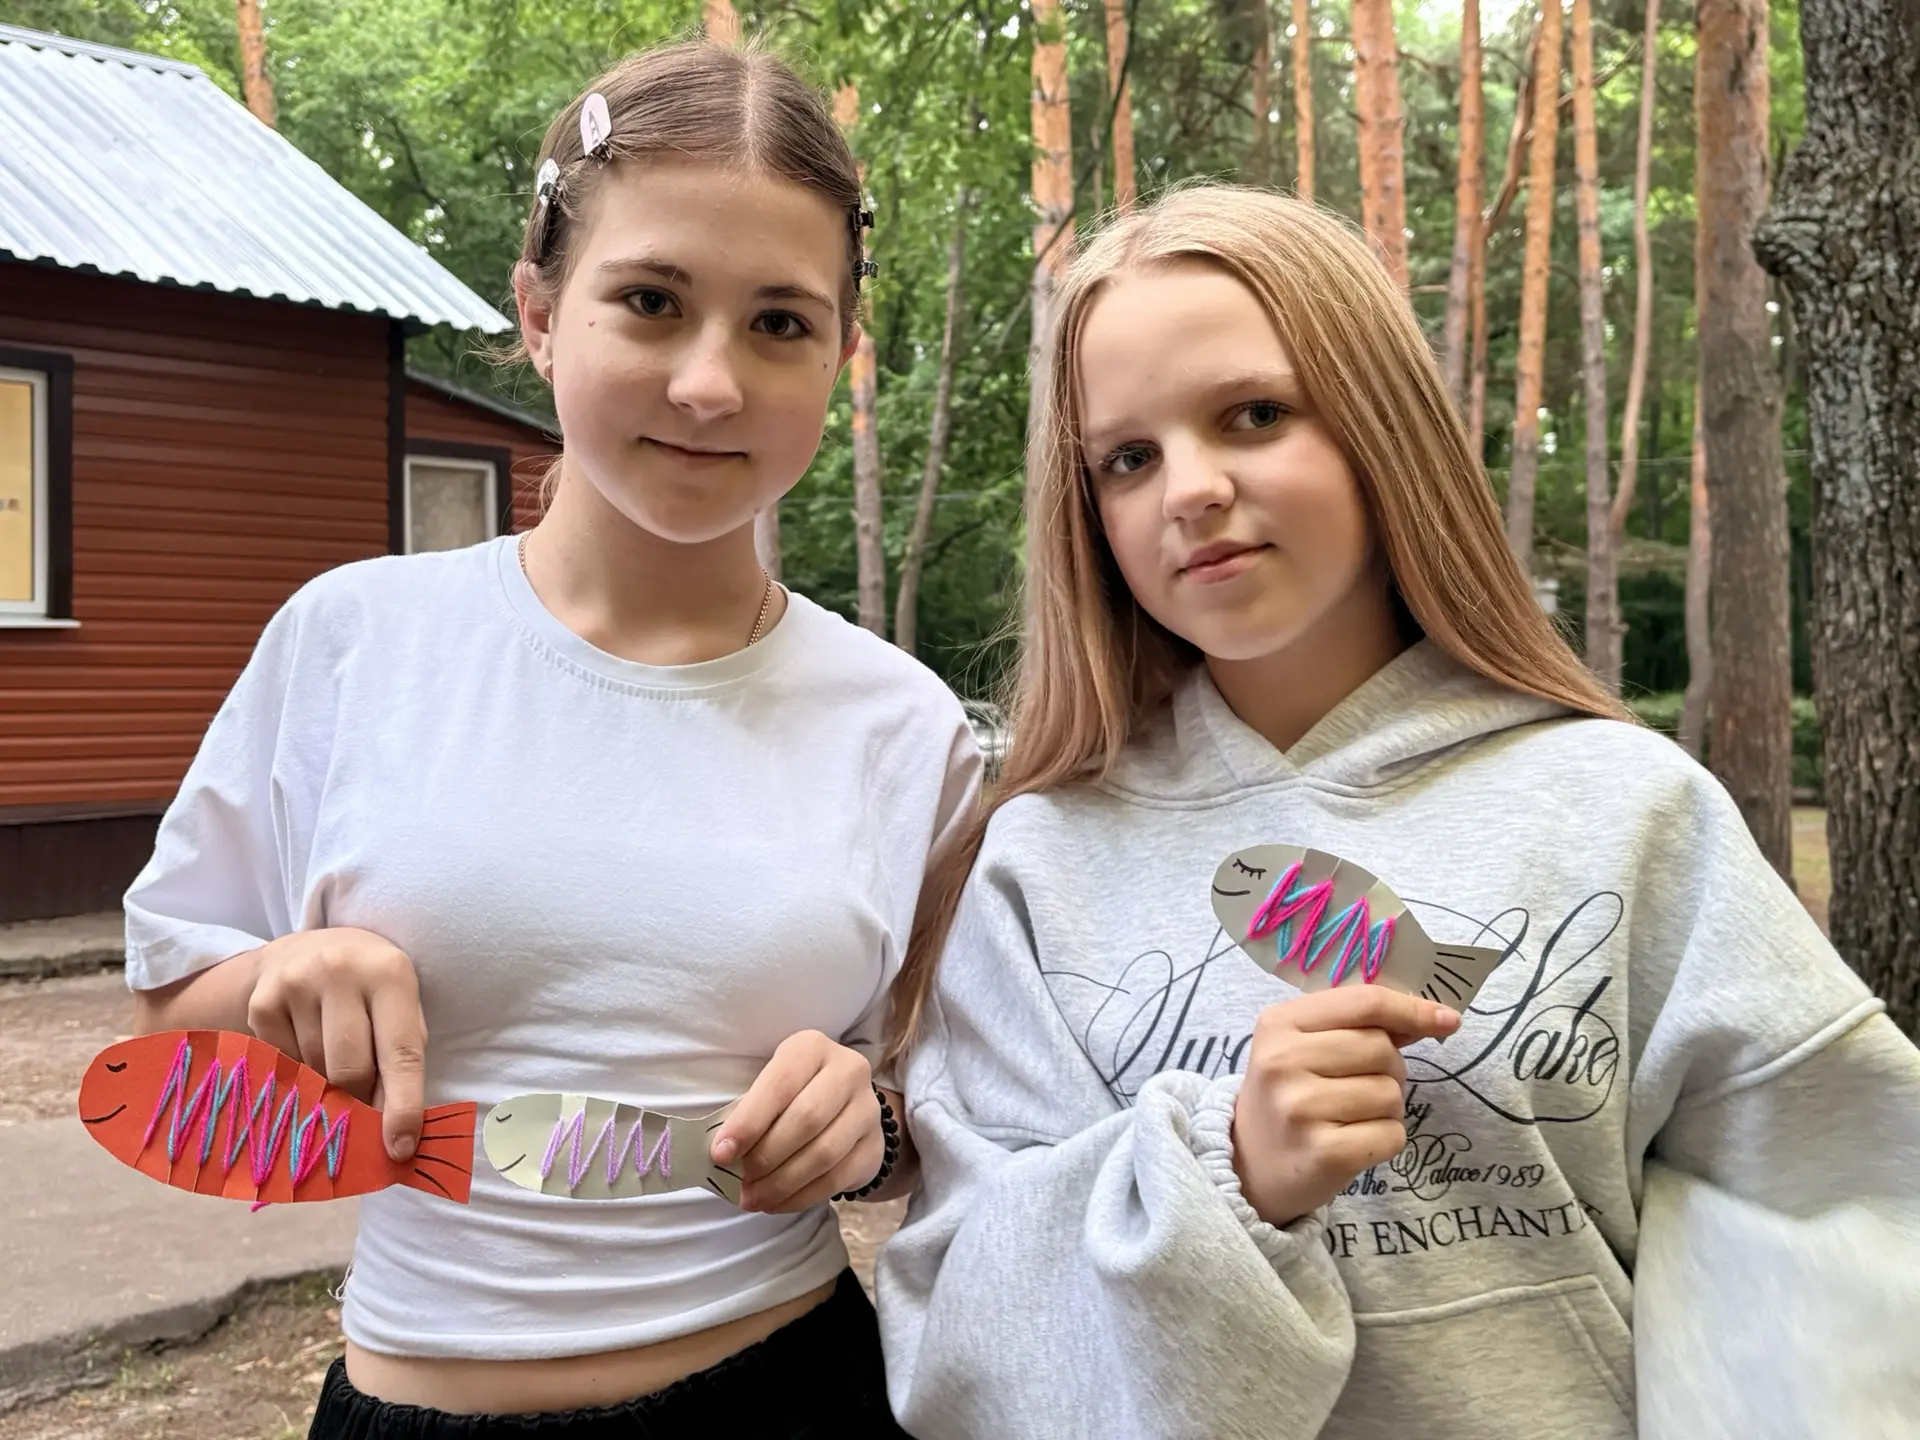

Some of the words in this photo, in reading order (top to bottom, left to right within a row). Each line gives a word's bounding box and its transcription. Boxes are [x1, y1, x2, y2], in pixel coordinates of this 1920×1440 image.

[1404, 890, 1624, 1124] Lake
[1390, 1133, 1480, 1200] Palace
[1481, 1163, 1544, 1188] 1989
